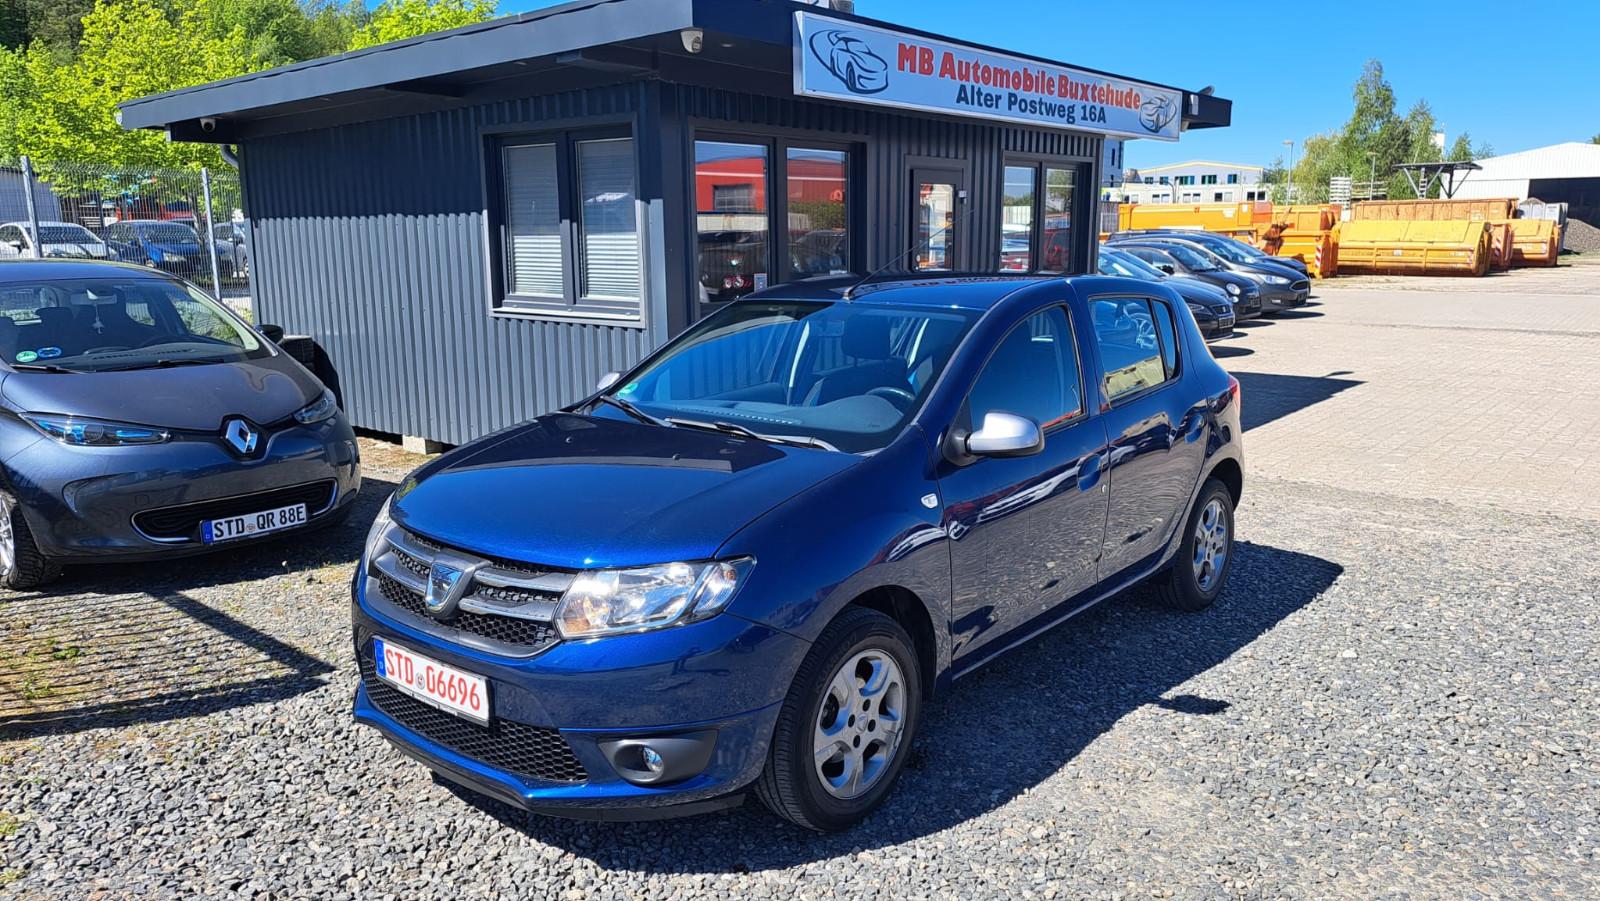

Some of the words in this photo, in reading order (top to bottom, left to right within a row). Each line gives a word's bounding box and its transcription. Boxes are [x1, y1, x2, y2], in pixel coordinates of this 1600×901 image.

[897, 42, 934, 76] MB
[939, 52, 1055, 96] Automobile
[1057, 74, 1141, 110] Buxtehude
[956, 84, 1002, 109] Alter
[1007, 92, 1075, 124] Postweg
[1080, 104, 1107, 124] 16A
[214, 518, 245, 538] STD
[256, 512, 276, 530] QR
[279, 505, 305, 525] 88E
[385, 648, 414, 685] STD
[426, 665, 480, 712] 06696
